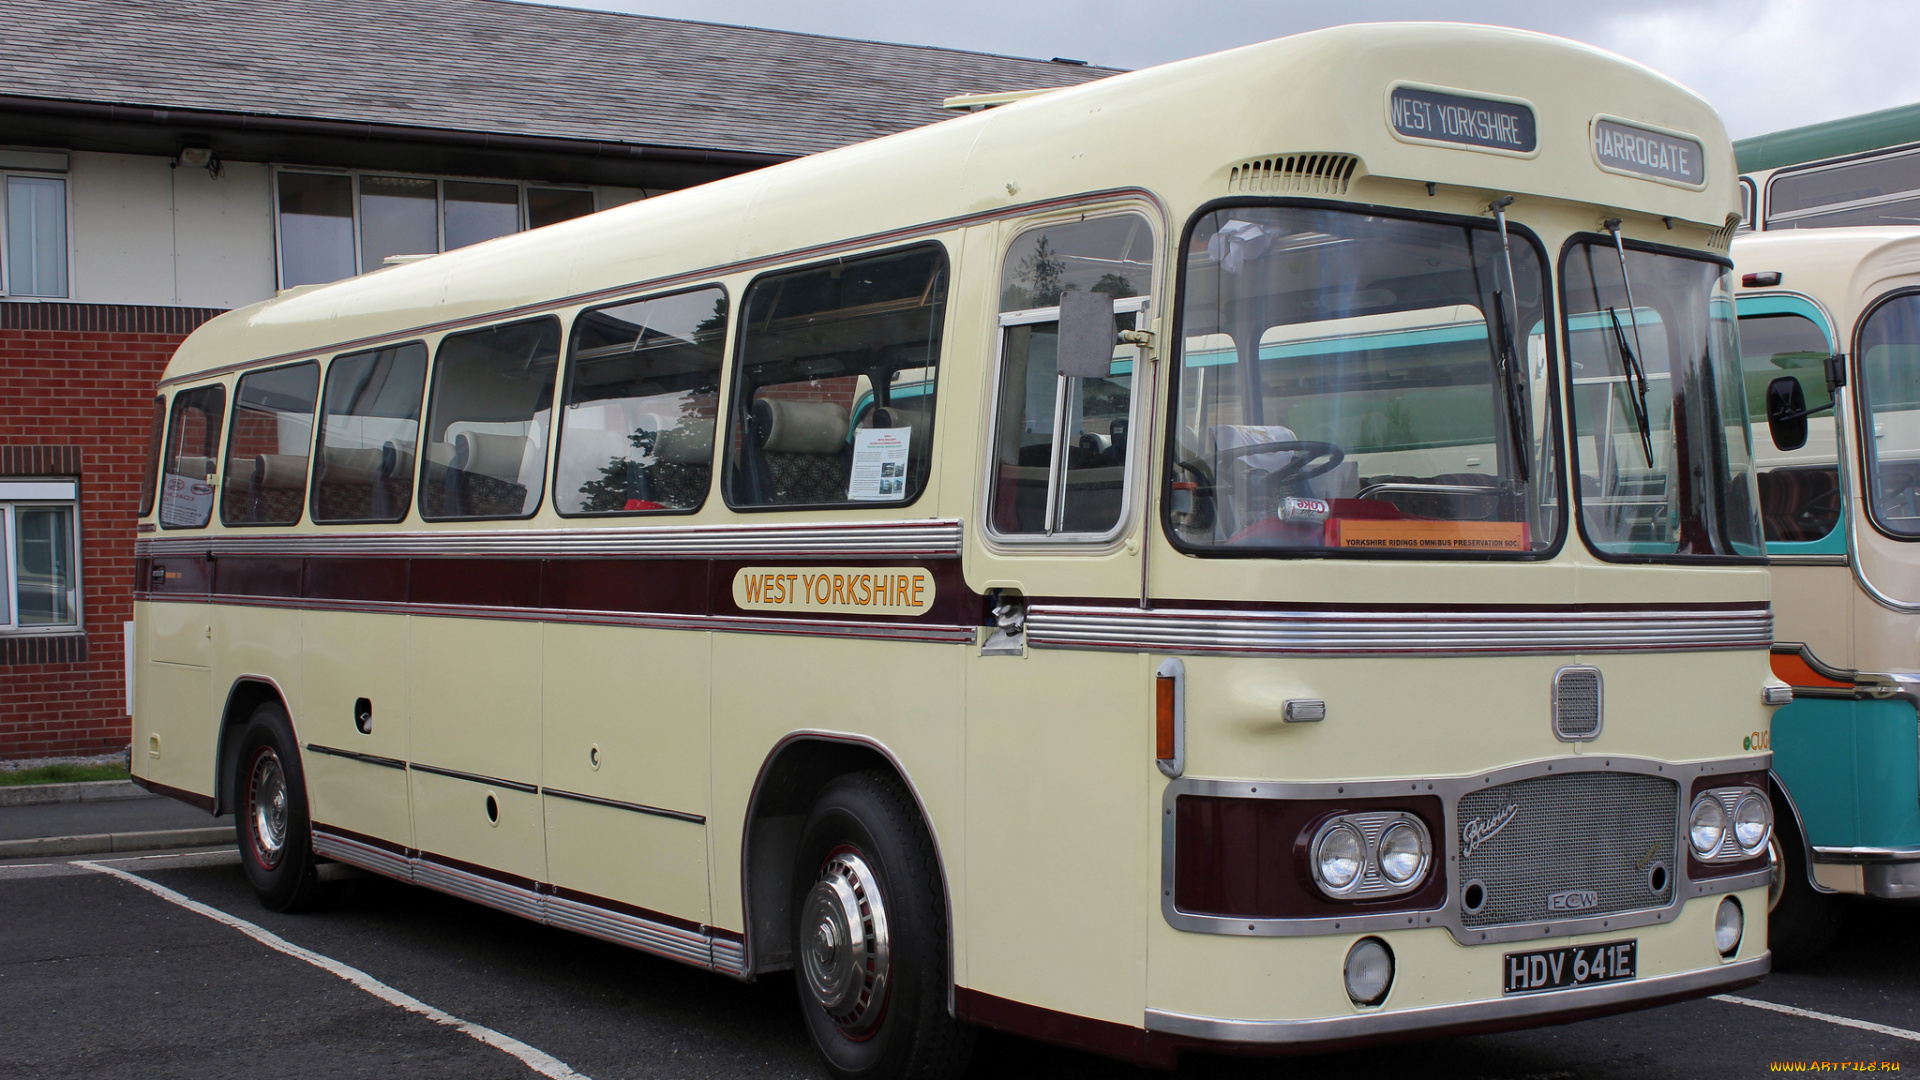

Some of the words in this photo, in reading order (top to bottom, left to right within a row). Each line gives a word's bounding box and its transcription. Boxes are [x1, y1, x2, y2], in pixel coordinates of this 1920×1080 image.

[1391, 97, 1431, 131] WEST
[1437, 104, 1522, 145] YORKSHIRE
[1297, 499, 1325, 513] Coke
[1345, 539, 1388, 547] YORKSHIRE
[1389, 539, 1418, 547] RIDINGS
[1419, 539, 1452, 547] OMNIBUS
[1453, 539, 1505, 547] PRESERVATION
[744, 574, 798, 604] WEST
[802, 574, 925, 607] YORKSHIRE
[1552, 893, 1594, 910] ECW
[1510, 952, 1565, 990] HDV
[1573, 945, 1631, 982] 641E
